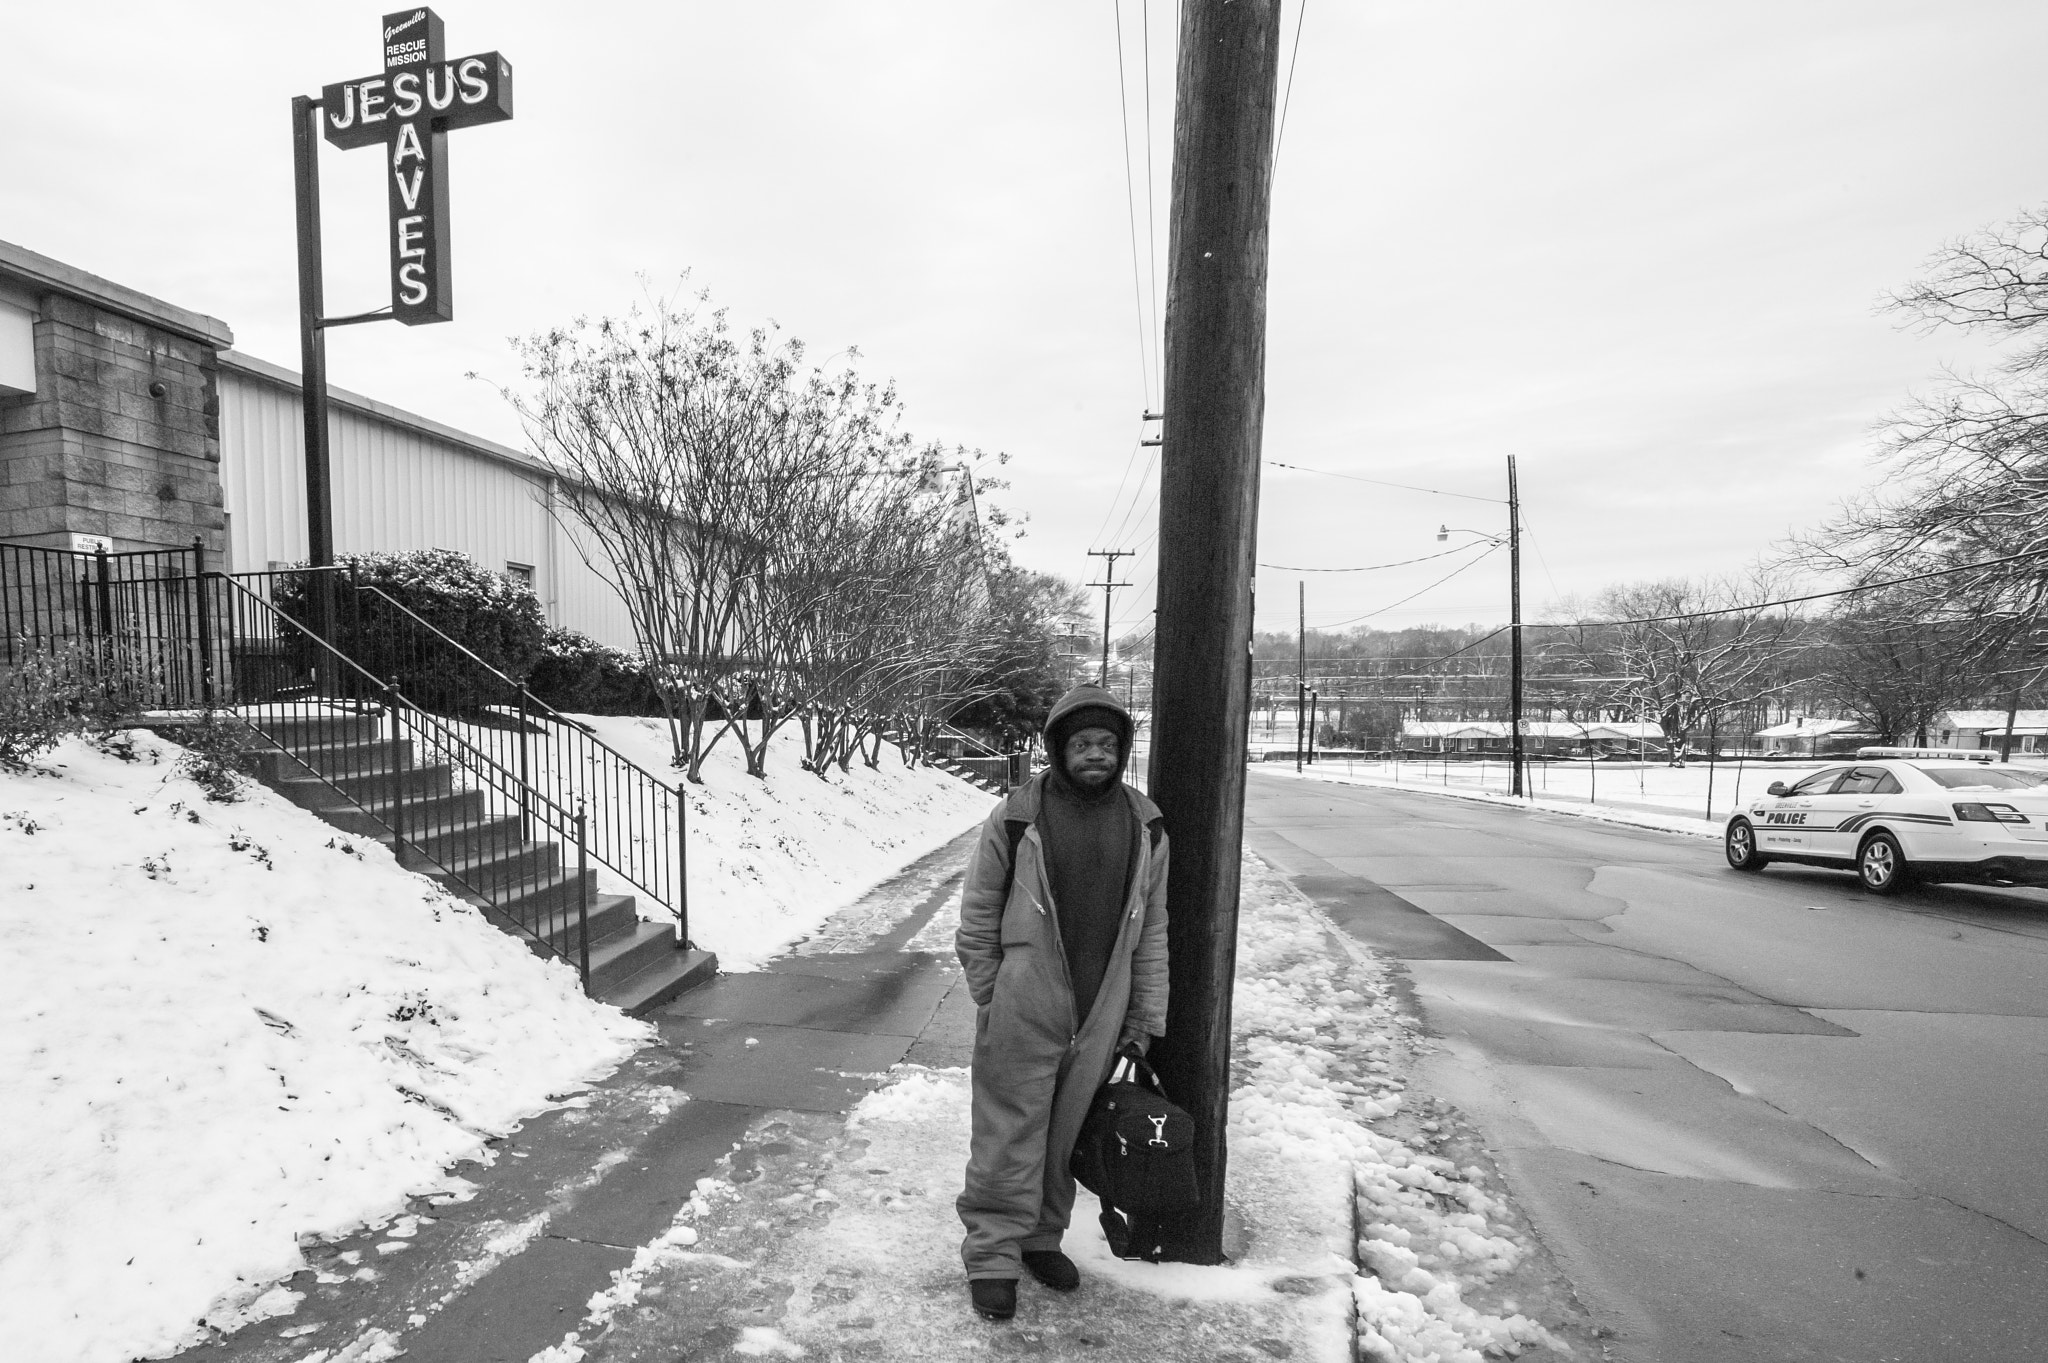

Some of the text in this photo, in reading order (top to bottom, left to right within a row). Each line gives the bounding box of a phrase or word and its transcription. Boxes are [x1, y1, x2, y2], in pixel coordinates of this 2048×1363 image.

[384, 10, 426, 42] Greenville
[386, 38, 426, 56] RESCUE
[387, 50, 427, 67] MISSION
[330, 58, 489, 129] JESUS
[1766, 813, 1807, 824] POLICE
